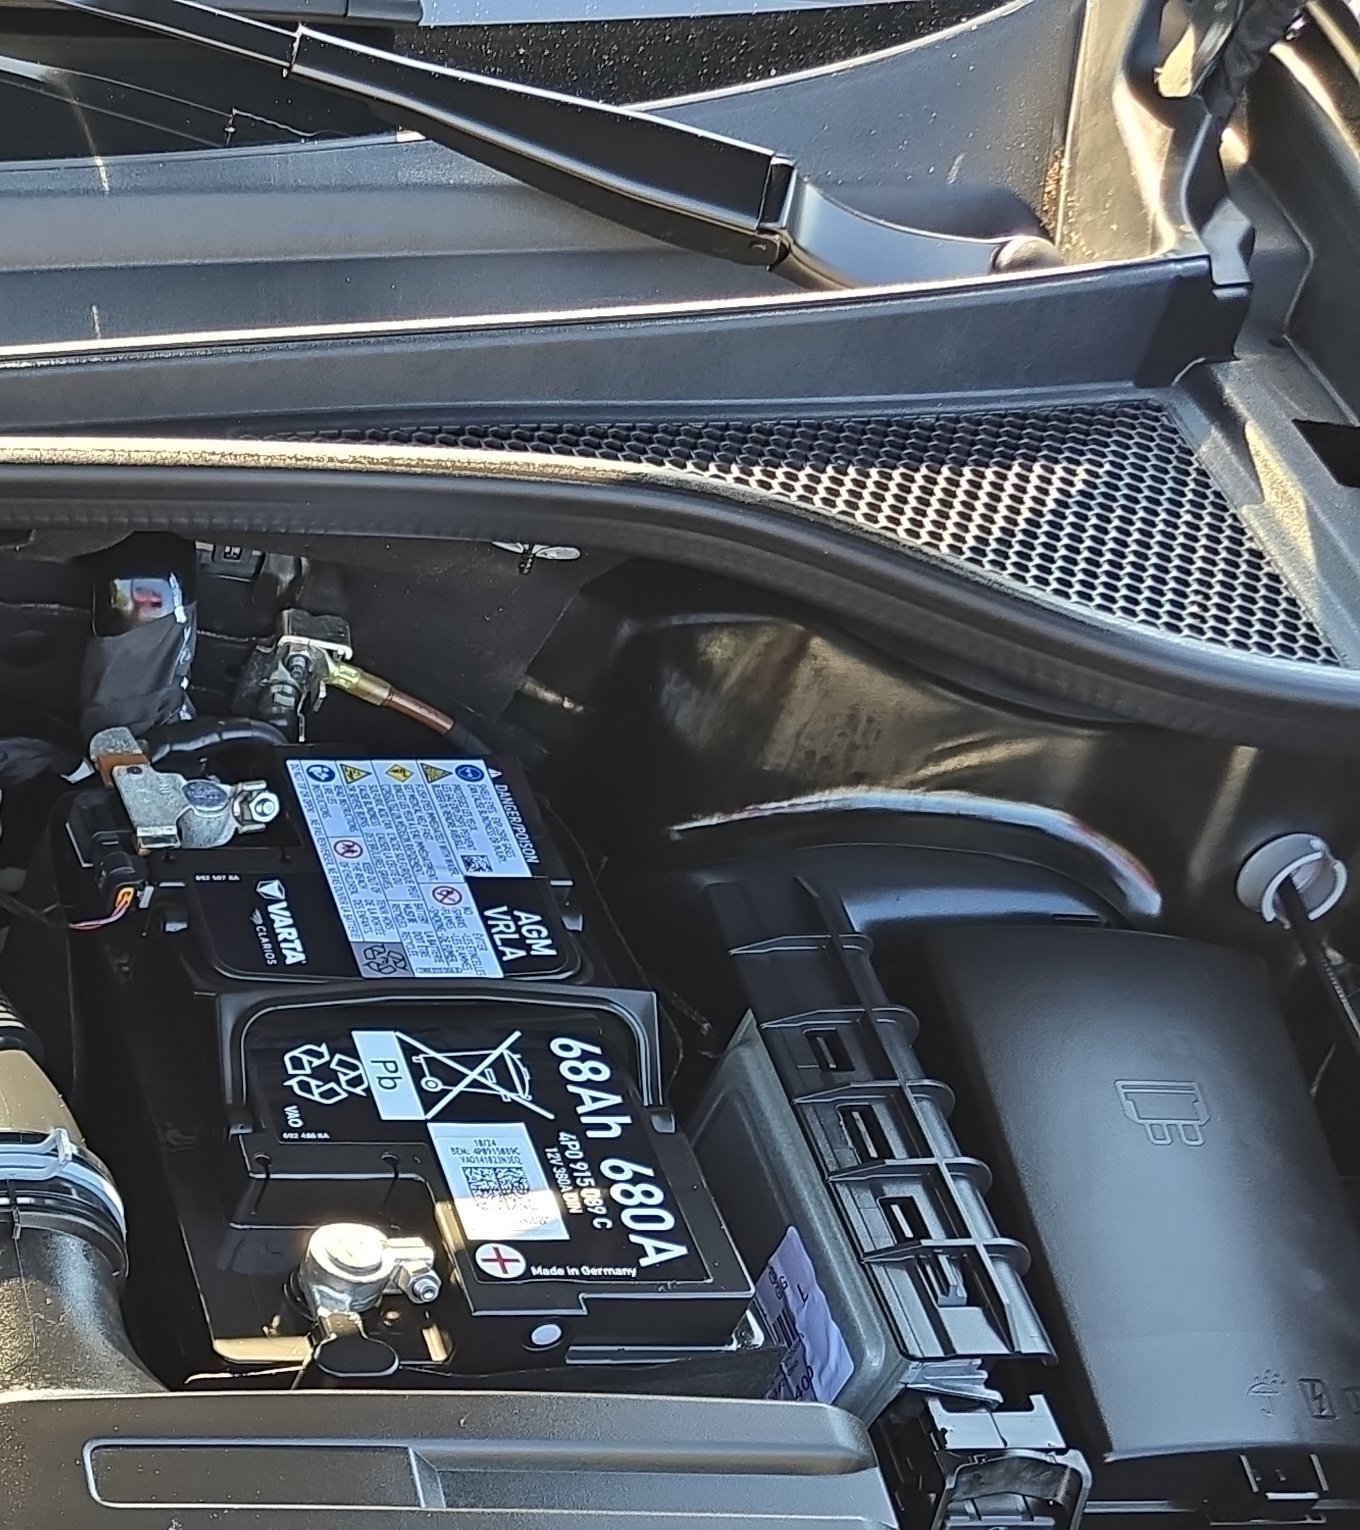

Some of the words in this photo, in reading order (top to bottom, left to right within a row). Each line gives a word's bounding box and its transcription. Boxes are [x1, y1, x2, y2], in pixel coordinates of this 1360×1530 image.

[495, 784, 539, 863] DANGER/POISON
[256, 926, 277, 965] CLARIOS
[268, 901, 306, 964] VARTA
[484, 906, 526, 961] VRLA
[513, 910, 557, 955] AGM
[370, 1060, 403, 1090] Pb
[544, 1147, 564, 1166] 12V
[549, 1037, 632, 1138] 68Ah
[599, 1158, 688, 1267] 680A
[558, 1131, 584, 1158] 4P0
[552, 1167, 574, 1192] 380A
[569, 1163, 596, 1186] 915
[562, 1193, 583, 1213] DIN
[592, 1217, 613, 1229] C
[530, 1266, 565, 1276] Made
[566, 1266, 580, 1276] in
[580, 1266, 637, 1278] Germany
